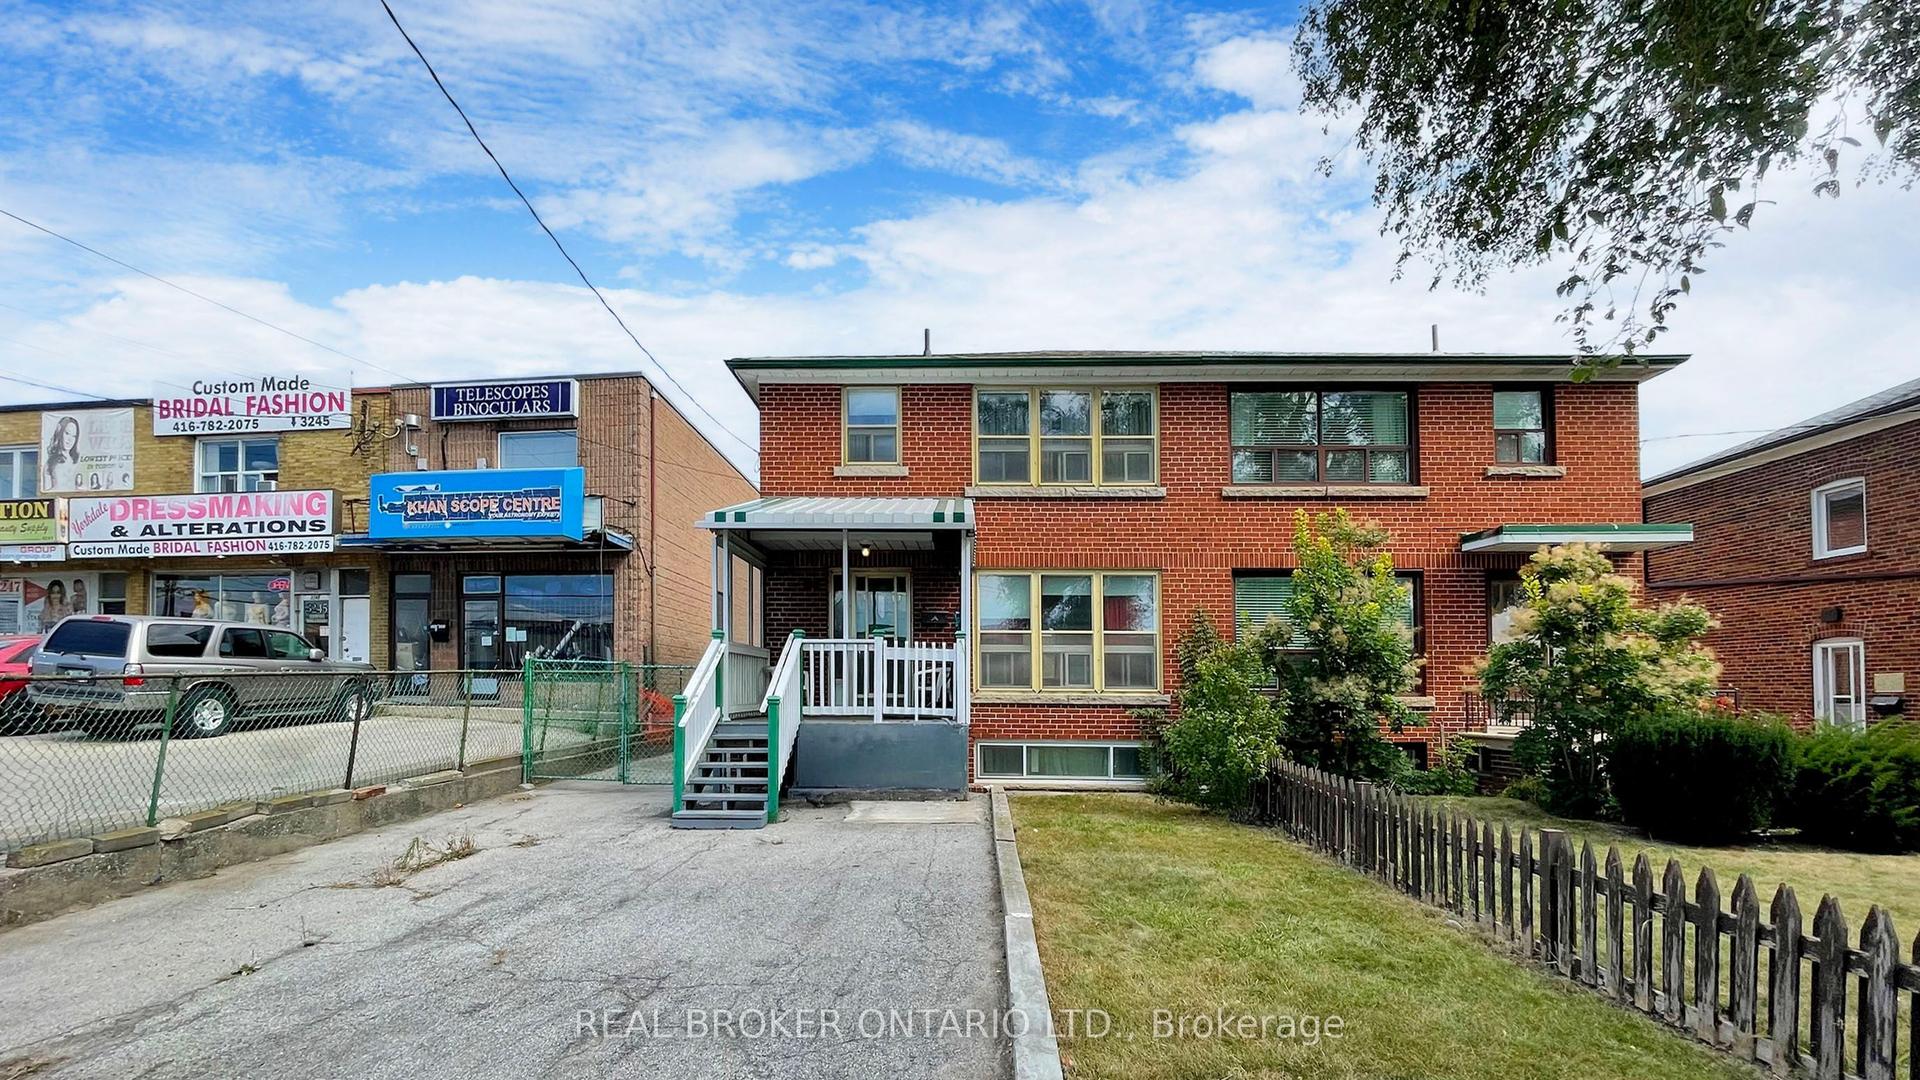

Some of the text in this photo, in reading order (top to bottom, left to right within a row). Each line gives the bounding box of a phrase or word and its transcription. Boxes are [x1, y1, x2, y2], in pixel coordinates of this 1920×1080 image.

[193, 375, 309, 395] Custom Made
[456, 385, 549, 401] TELESCOPES
[159, 392, 344, 419] BRIDAL FASHION
[453, 400, 551, 416] BINOCULARS
[172, 416, 330, 433] 416-782-2075 3245
[72, 502, 108, 535] Yorkdale
[109, 492, 326, 521] DRESSMAKING
[407, 497, 560, 516] KHAN SCOPE CENTRE
[110, 520, 326, 537] & ALTERATIONS
[73, 540, 330, 556] Custom Made BRIDAL FASHION 416-782-2075
